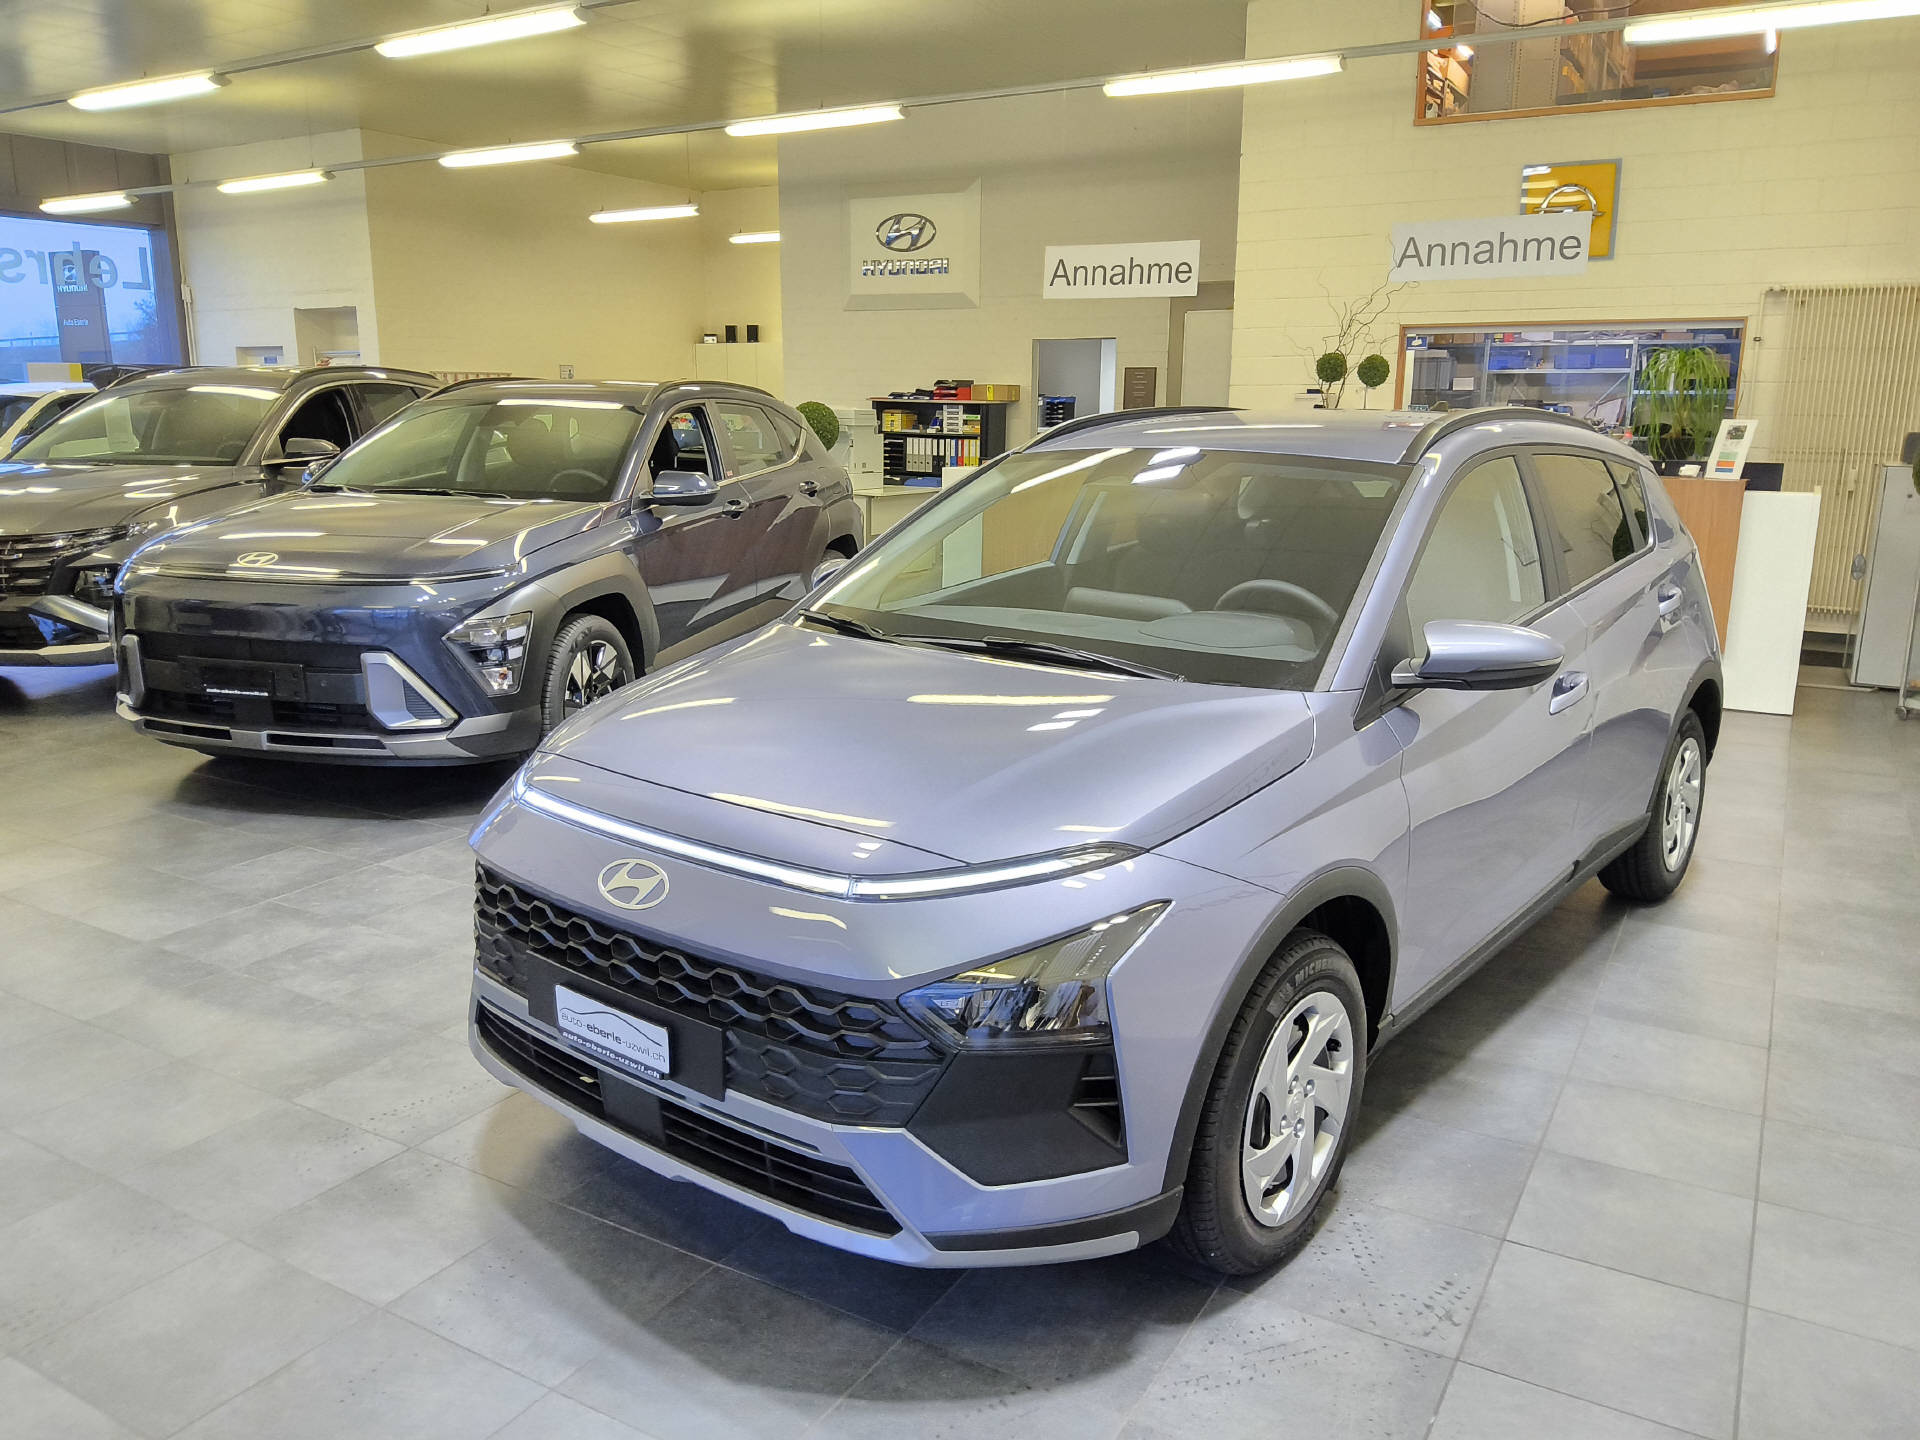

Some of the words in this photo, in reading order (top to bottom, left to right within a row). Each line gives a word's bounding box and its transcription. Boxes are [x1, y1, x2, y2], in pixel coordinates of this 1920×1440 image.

[862, 258, 949, 276] HYUNDAI
[1397, 231, 1582, 268] Annahme
[1049, 256, 1193, 287] Annahme
[561, 1012, 666, 1063] auto-eberle-uzwil.ch
[562, 1031, 661, 1080] auto-eberle-uzwil.ch
